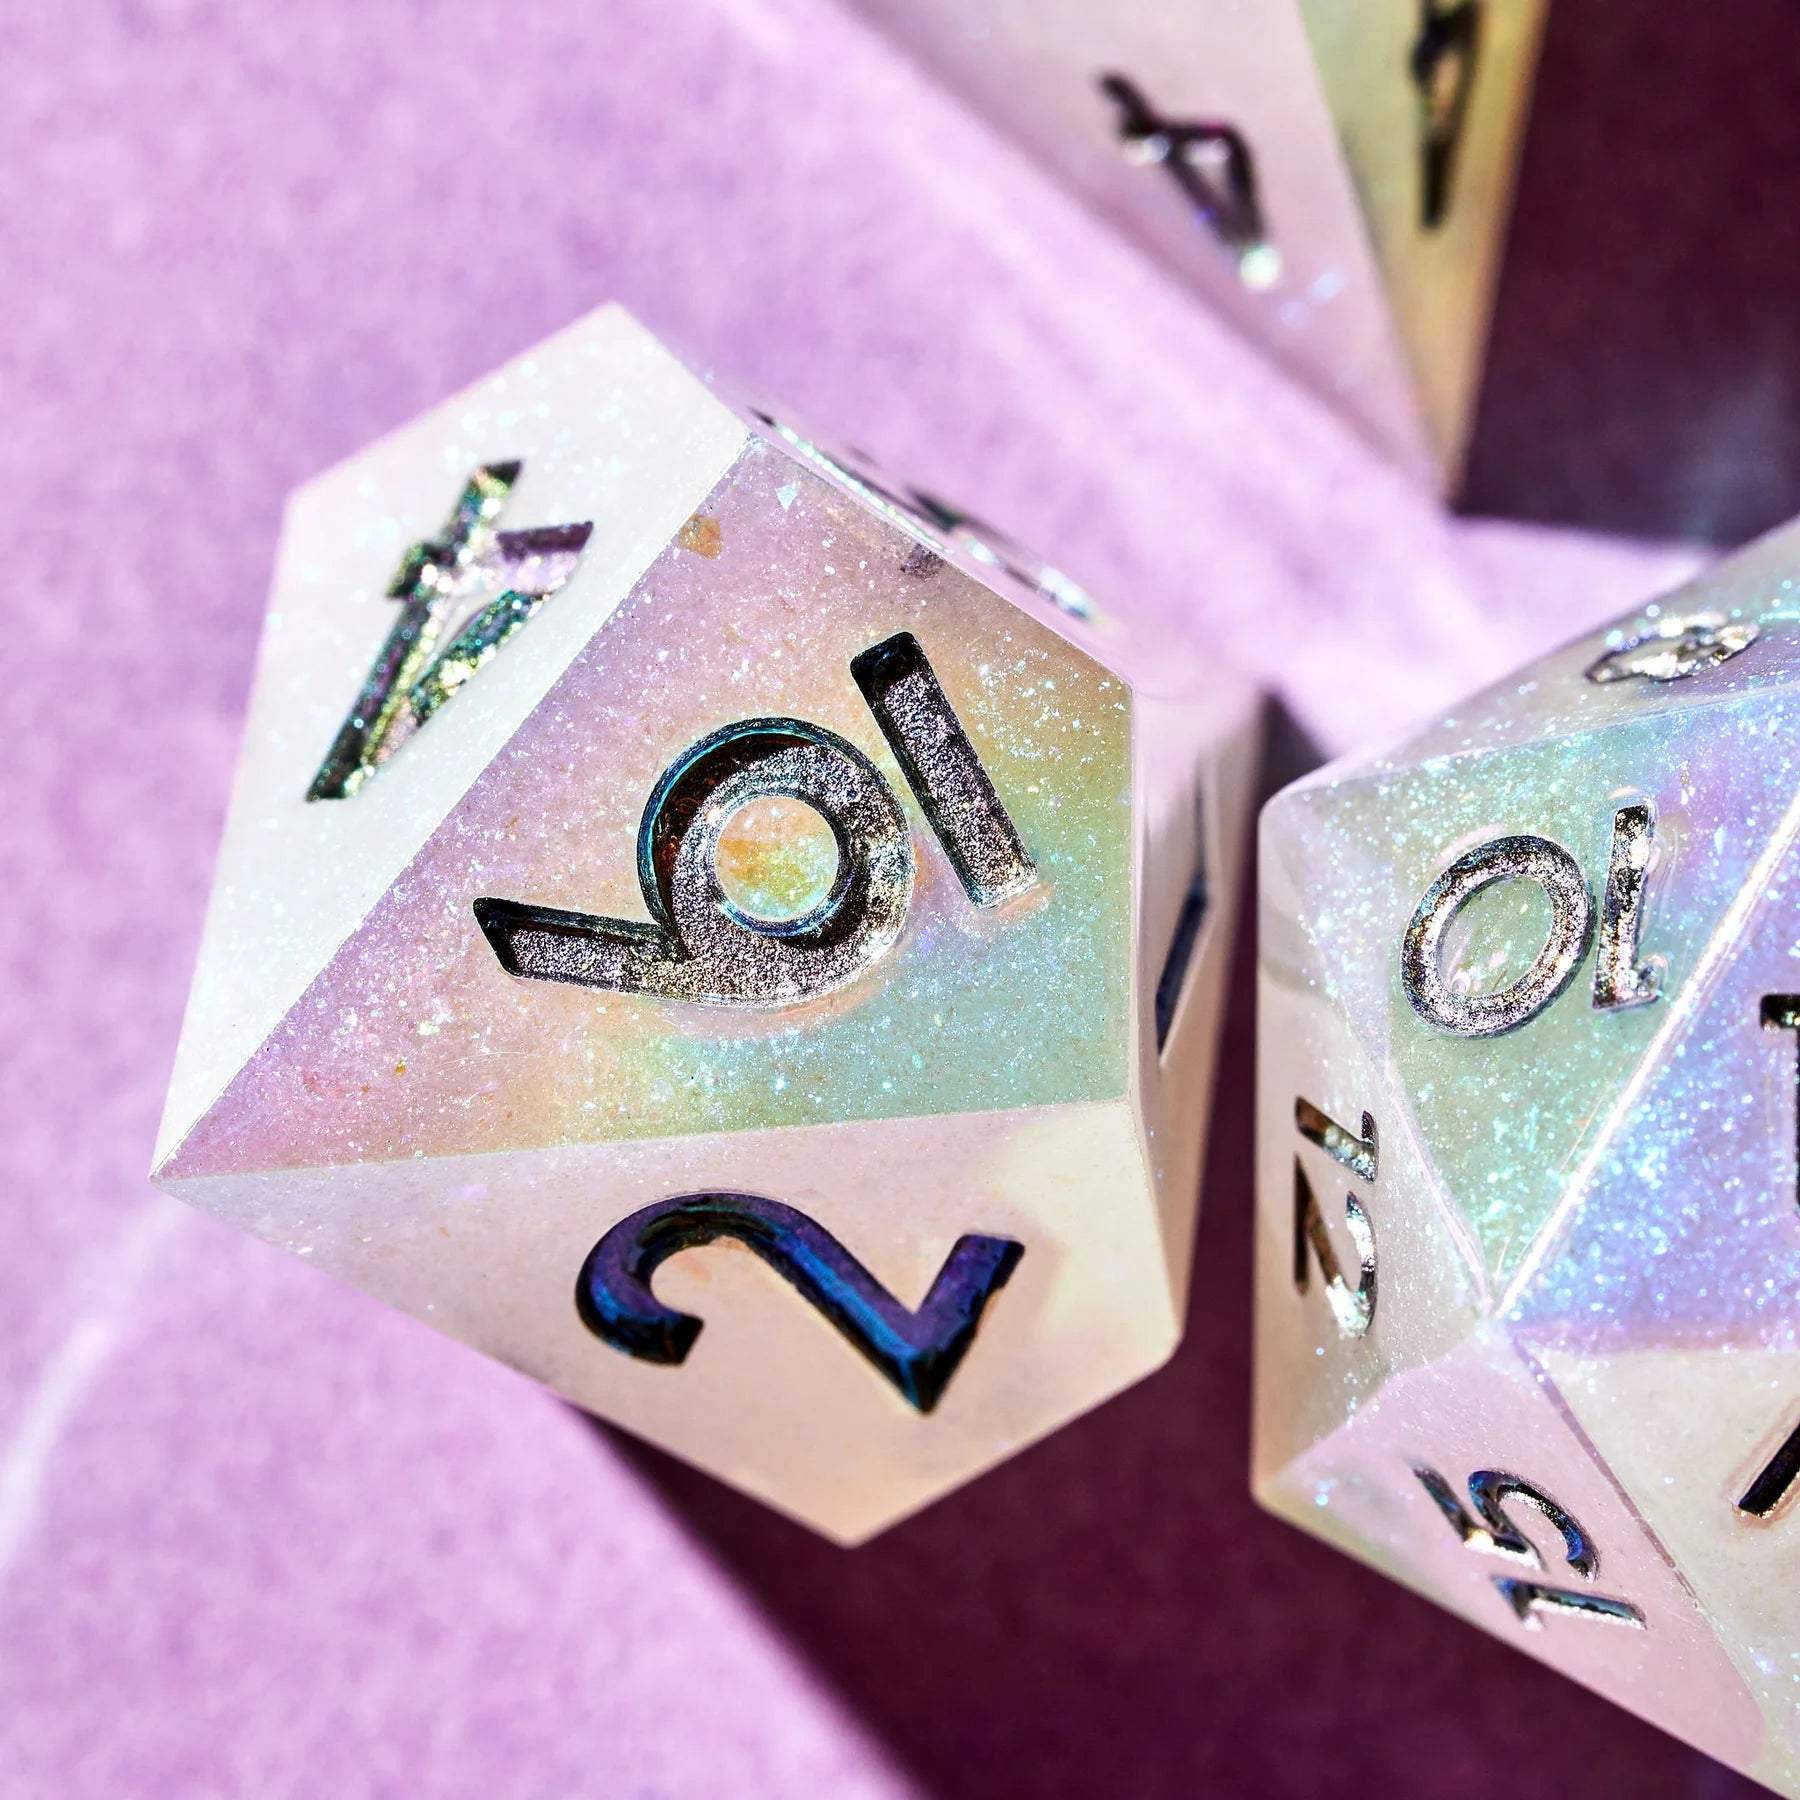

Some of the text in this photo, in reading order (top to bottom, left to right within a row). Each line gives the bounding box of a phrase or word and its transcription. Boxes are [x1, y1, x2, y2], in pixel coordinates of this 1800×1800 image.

[303, 459, 594, 804] 4
[1401, 803, 1659, 1040] 10
[576, 1190, 1026, 1415] 2
[1294, 1096, 1377, 1338] 12
[1412, 1467, 1647, 1630] 15
